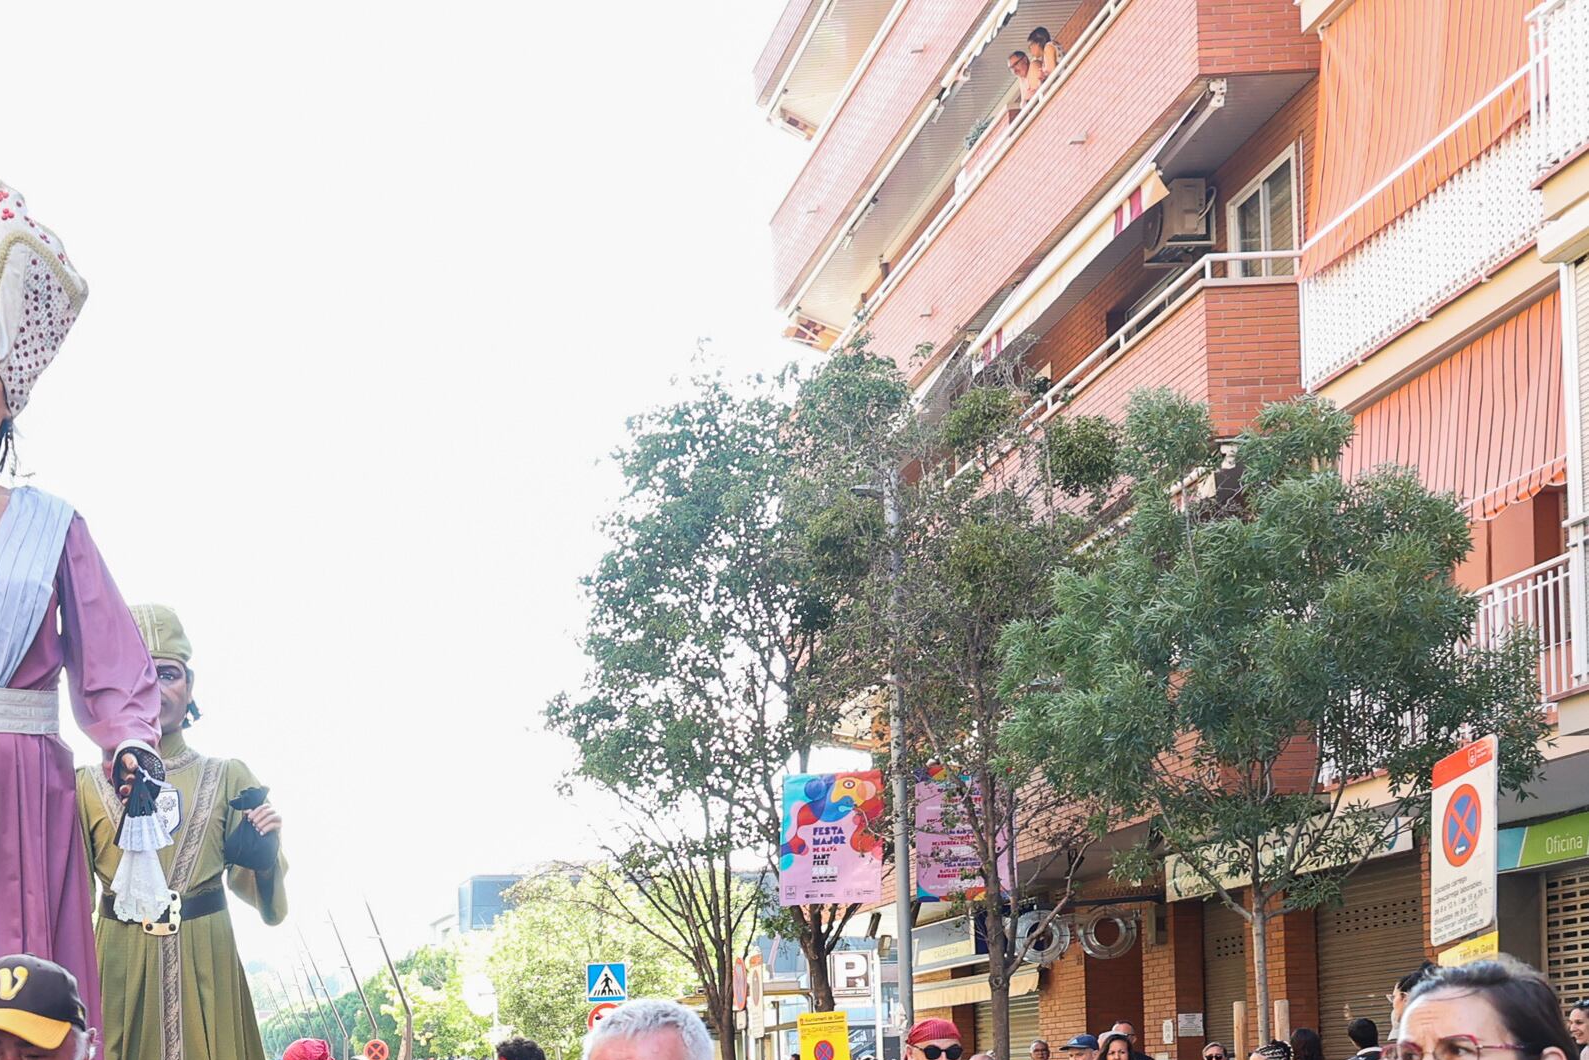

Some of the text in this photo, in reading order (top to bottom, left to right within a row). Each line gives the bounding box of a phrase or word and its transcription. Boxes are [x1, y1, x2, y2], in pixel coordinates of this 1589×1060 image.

[813, 826, 844, 836] FESTA
[813, 836, 846, 845] MAJOR
[1545, 831, 1583, 855] Oficina
